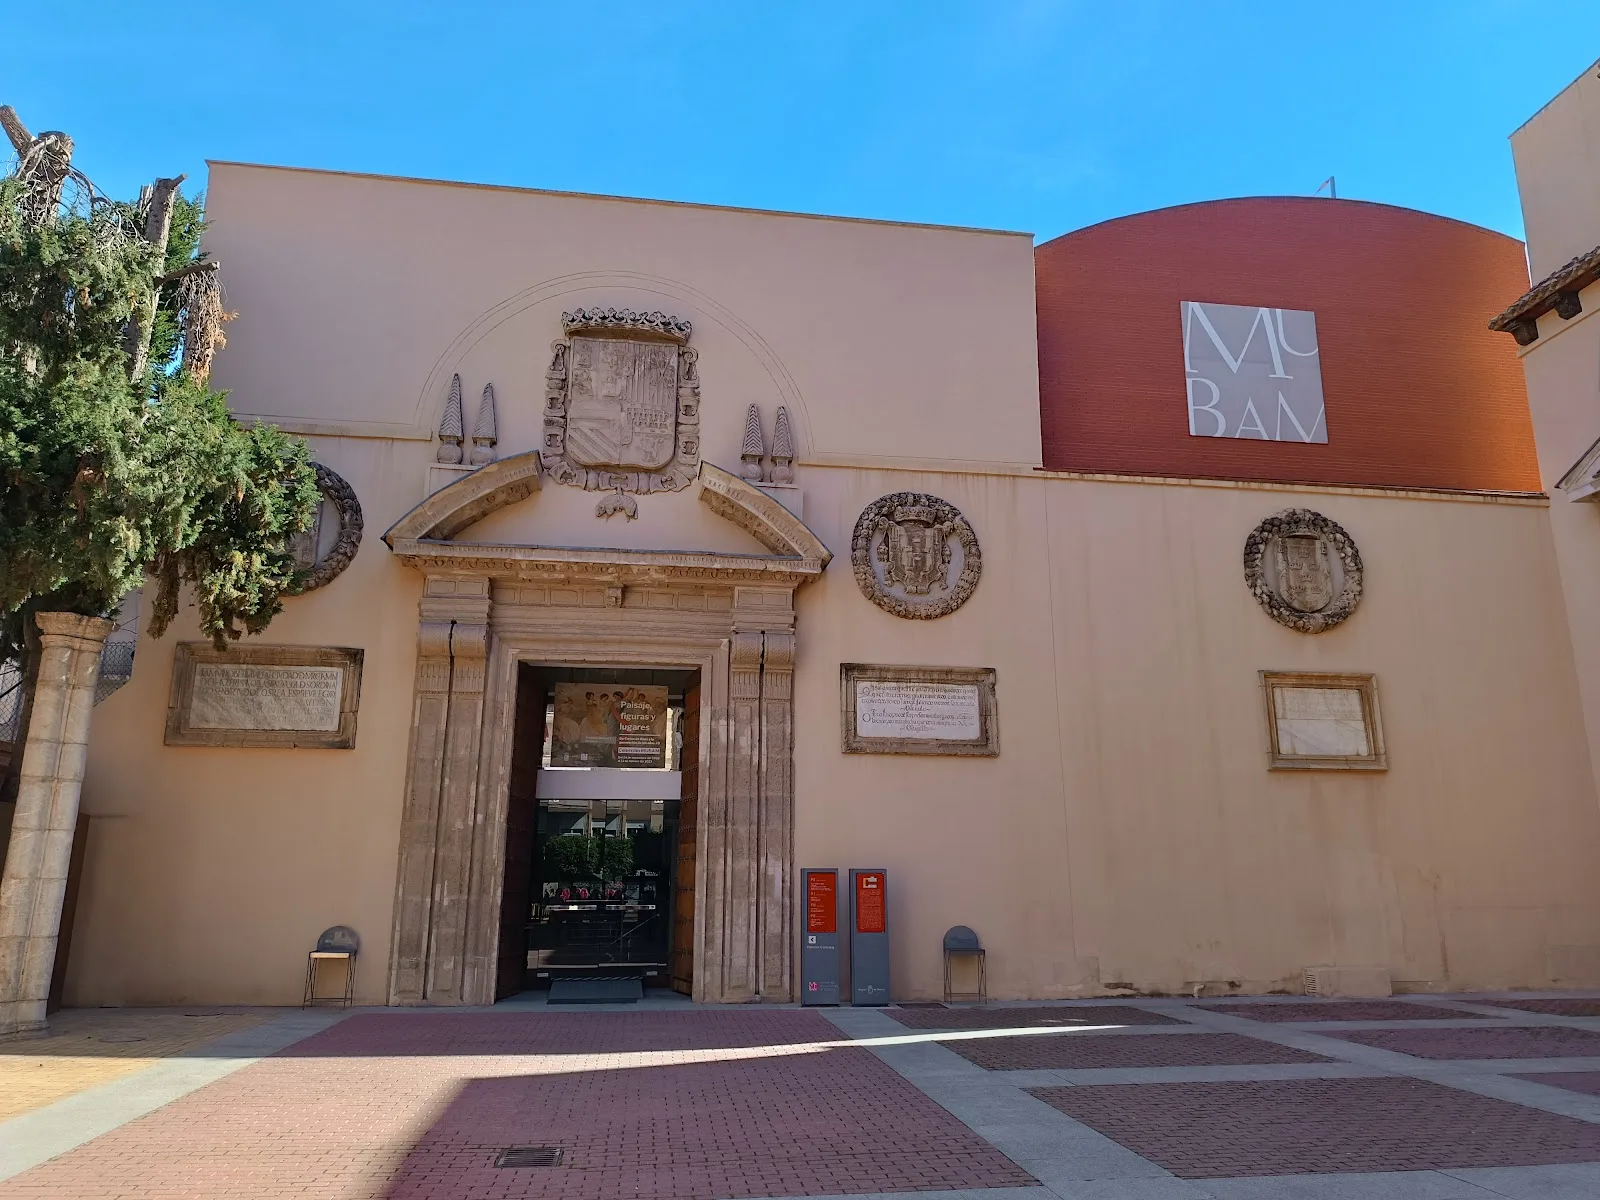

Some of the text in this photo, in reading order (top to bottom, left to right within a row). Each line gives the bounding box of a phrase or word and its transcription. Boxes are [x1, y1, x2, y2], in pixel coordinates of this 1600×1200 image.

[620, 701, 652, 711] Paisaje,
[620, 712, 649, 722] figuras
[619, 723, 650, 732] lugares
